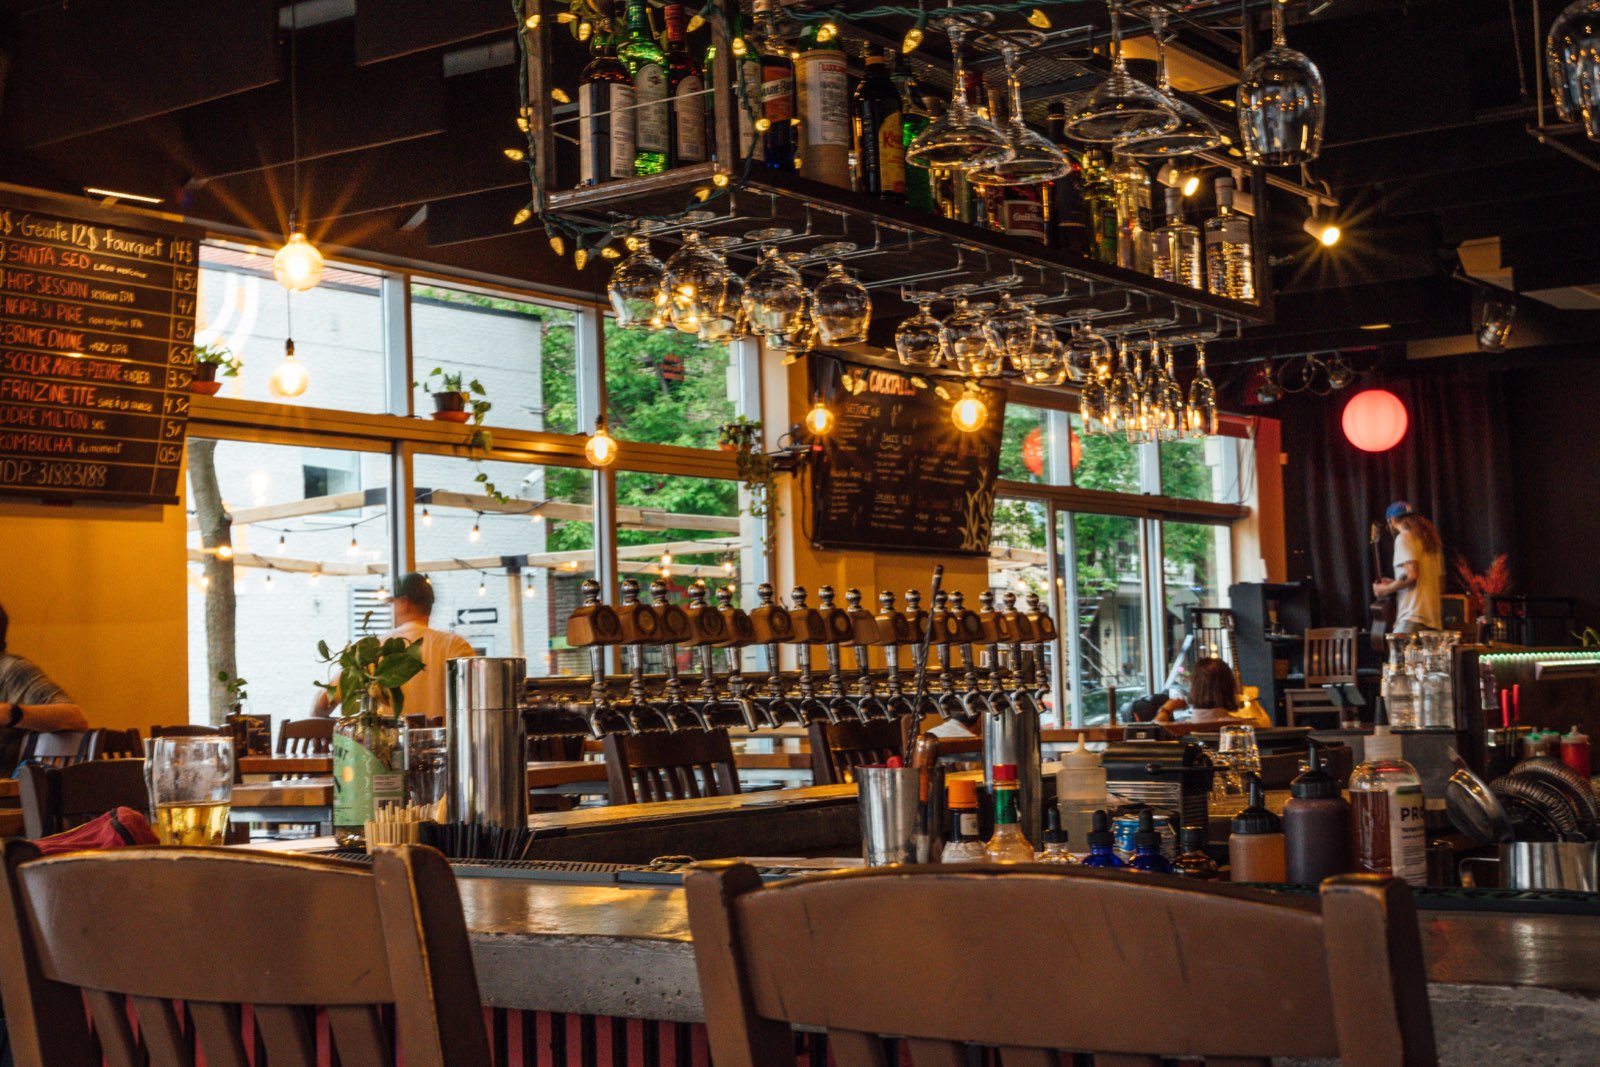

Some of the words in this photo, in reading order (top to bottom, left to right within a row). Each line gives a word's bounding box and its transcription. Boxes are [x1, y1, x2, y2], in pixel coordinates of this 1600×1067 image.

[71, 223, 99, 252] 12$
[8, 243, 57, 266] SANTA
[60, 251, 92, 270] SED
[7, 271, 35, 291] HOP
[37, 275, 89, 299] SESSION
[5, 296, 39, 317] NEIPA
[56, 304, 85, 324] PIRE
[5, 324, 47, 346] BRUME
[48, 329, 86, 351] DIVINE
[111, 344, 129, 355] IPA
[5, 351, 50, 375] SOEUR
[1, 379, 97, 406] FRAIZNETTE
[0, 407, 37, 426] CIDRE
[41, 409, 88, 430] MILTON
[0, 434, 74, 453] KOMBUCHA
[89, 443, 122, 454] moment
